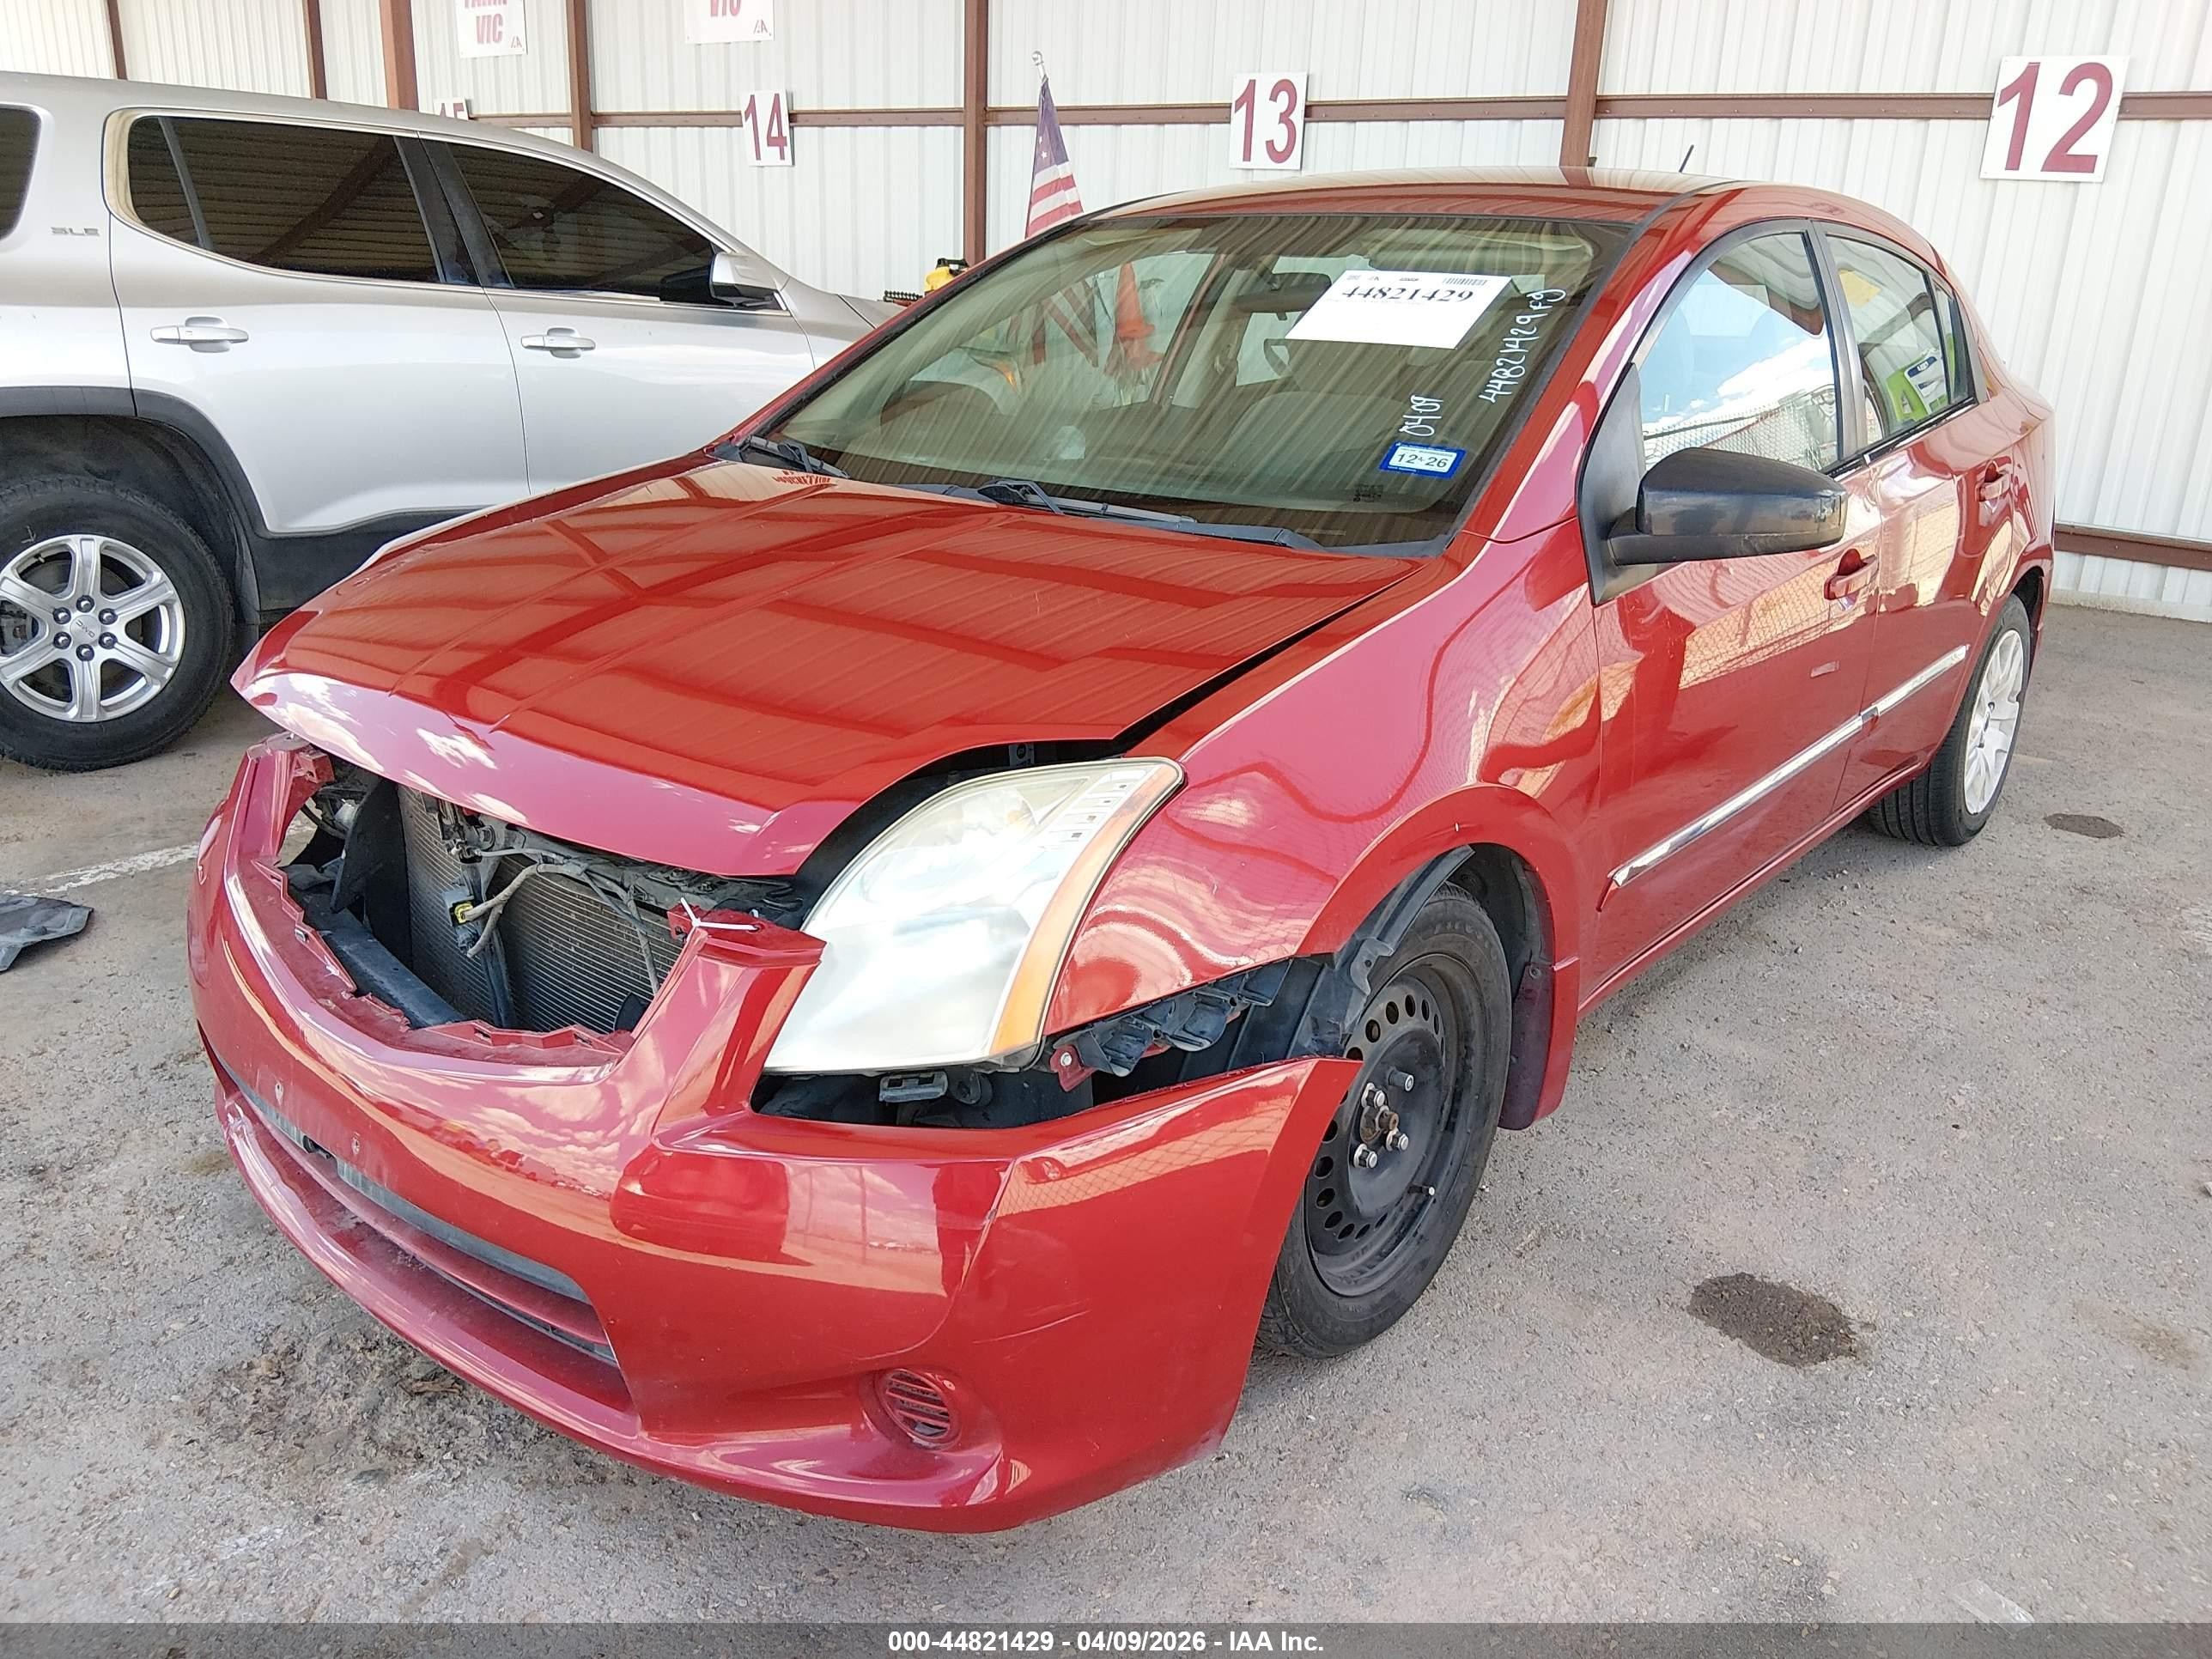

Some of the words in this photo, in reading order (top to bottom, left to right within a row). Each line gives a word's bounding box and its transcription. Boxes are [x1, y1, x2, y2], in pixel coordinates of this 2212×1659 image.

[476, 13, 504, 45] VIC
[744, 93, 787, 161] 14
[1234, 78, 1297, 164] 13
[1997, 62, 2113, 173] 12
[1341, 285, 1474, 303] 44821429
[1396, 453, 1419, 465] 12
[1425, 456, 1449, 468] 26
